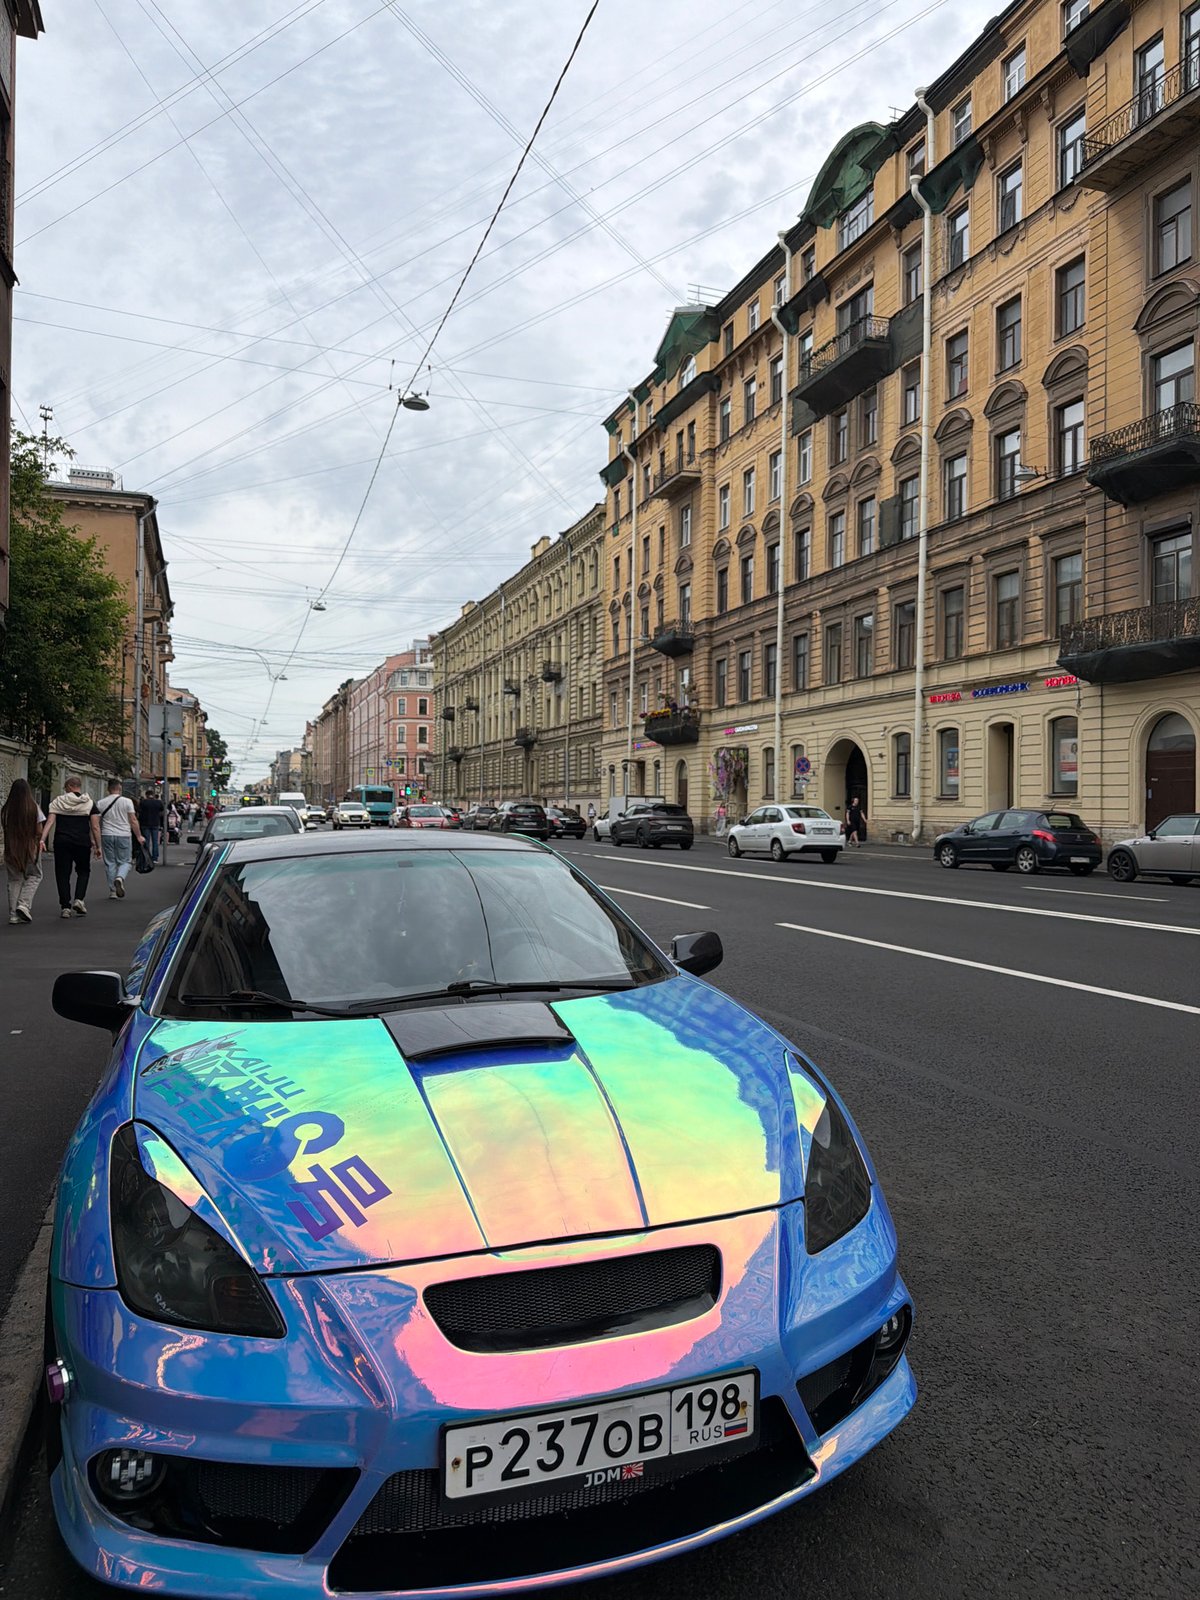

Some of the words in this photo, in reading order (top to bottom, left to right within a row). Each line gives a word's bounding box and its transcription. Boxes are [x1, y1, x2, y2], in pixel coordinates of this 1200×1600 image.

[224, 1048, 306, 1100] KAIJU
[675, 1383, 740, 1430] 198
[689, 1425, 723, 1444] RUS
[583, 1467, 621, 1488] JDM
